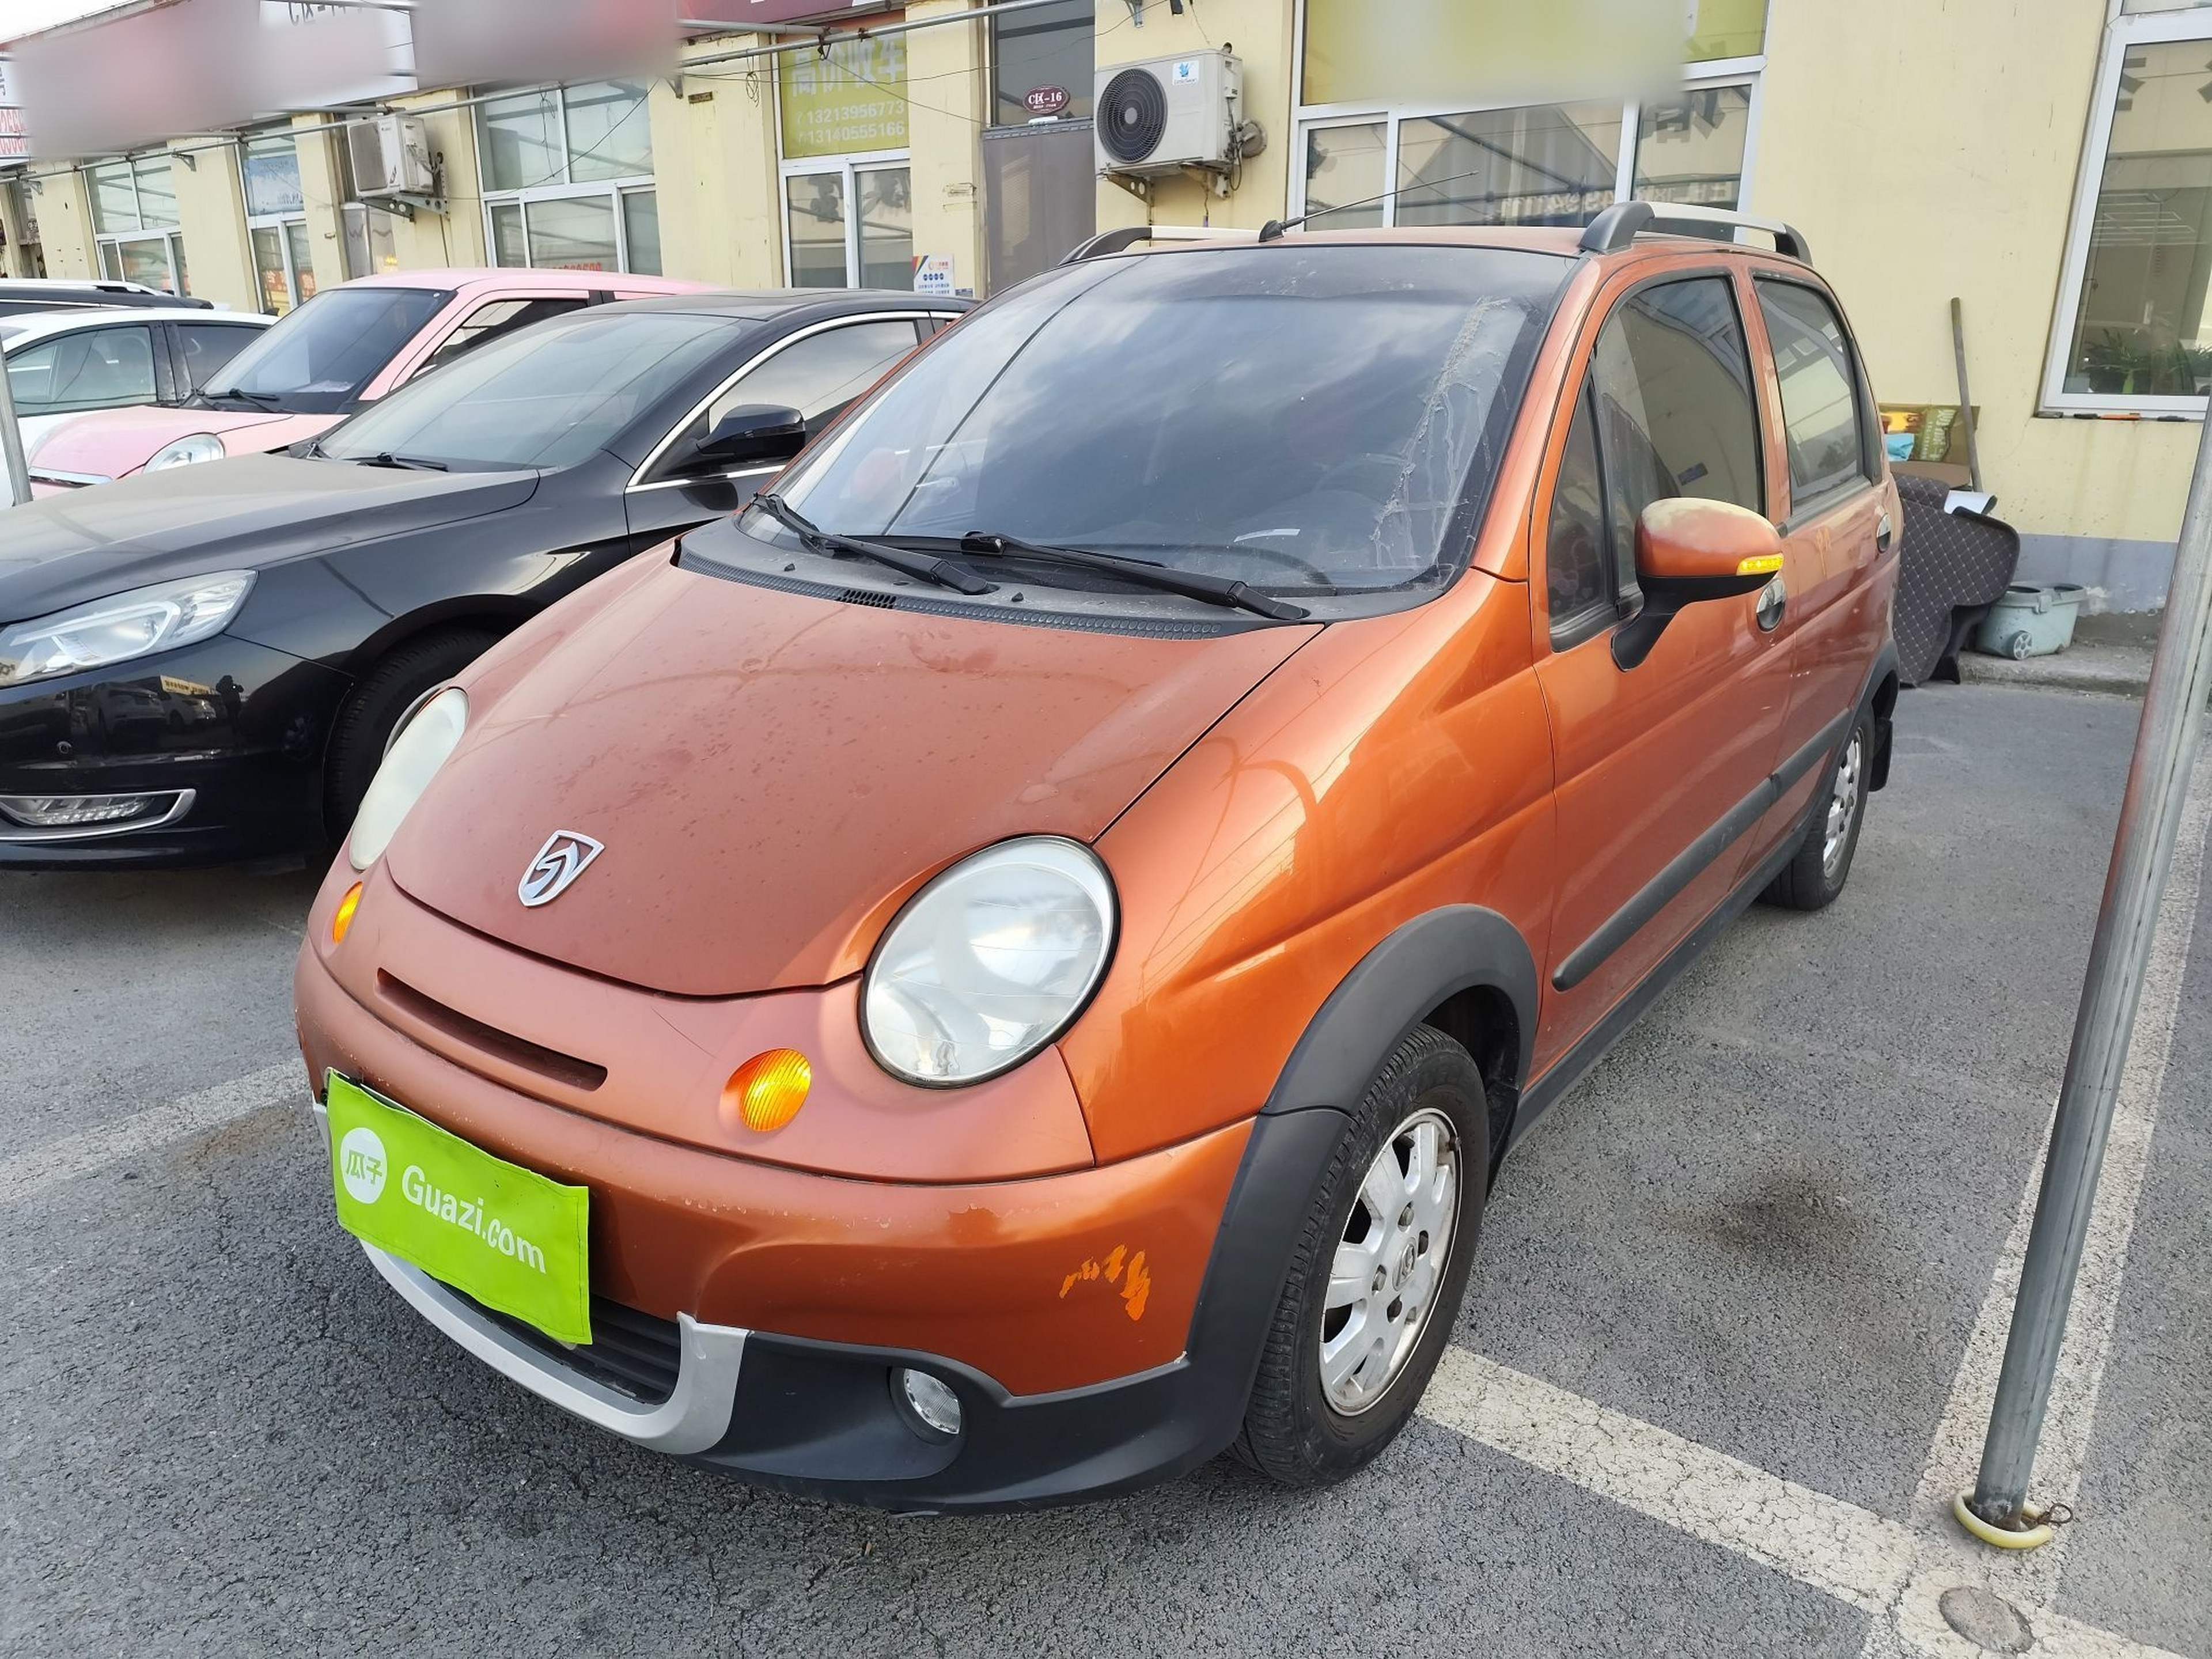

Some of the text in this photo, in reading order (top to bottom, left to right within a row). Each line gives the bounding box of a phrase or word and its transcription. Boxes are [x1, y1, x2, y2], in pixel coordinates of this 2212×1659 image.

[791, 34, 905, 97] 高价收车
[808, 101, 904, 124] 13213956773
[1028, 92, 1062, 104] C区-16
[346, 1150, 383, 1186] 瓜子
[401, 1165, 547, 1274] Guazi.com
